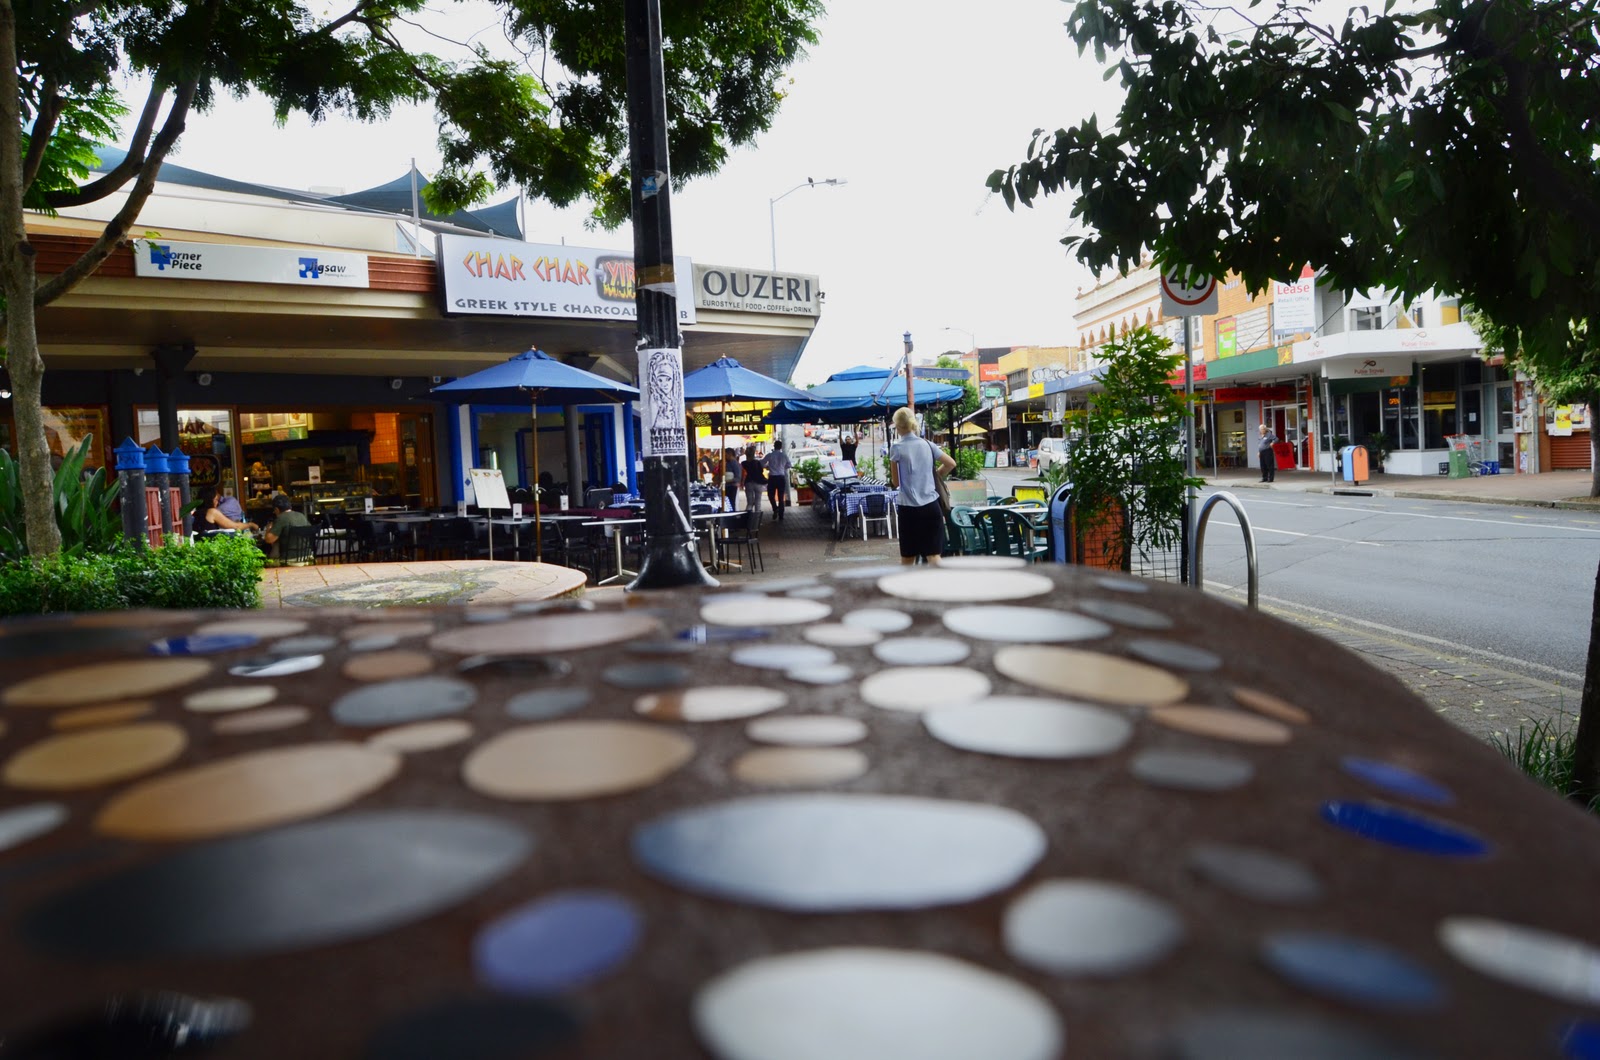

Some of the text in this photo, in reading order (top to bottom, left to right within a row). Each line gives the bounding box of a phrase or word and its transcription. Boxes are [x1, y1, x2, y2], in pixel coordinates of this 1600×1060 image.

[171, 259, 202, 270] Piece
[309, 261, 346, 274] Jigsaw
[463, 250, 526, 281] CHAR
[532, 255, 591, 286] CHAR
[703, 270, 811, 302] OUZERI
[1277, 284, 1310, 295] Lease
[455, 298, 637, 317] GREEK STYLE CHARCOAL
[702, 299, 741, 309] EUROSTYLE
[745, 302, 762, 311] FOOD
[793, 306, 812, 314] DRINK
[726, 413, 762, 423] Hall's
[650, 427, 672, 435] WEST
